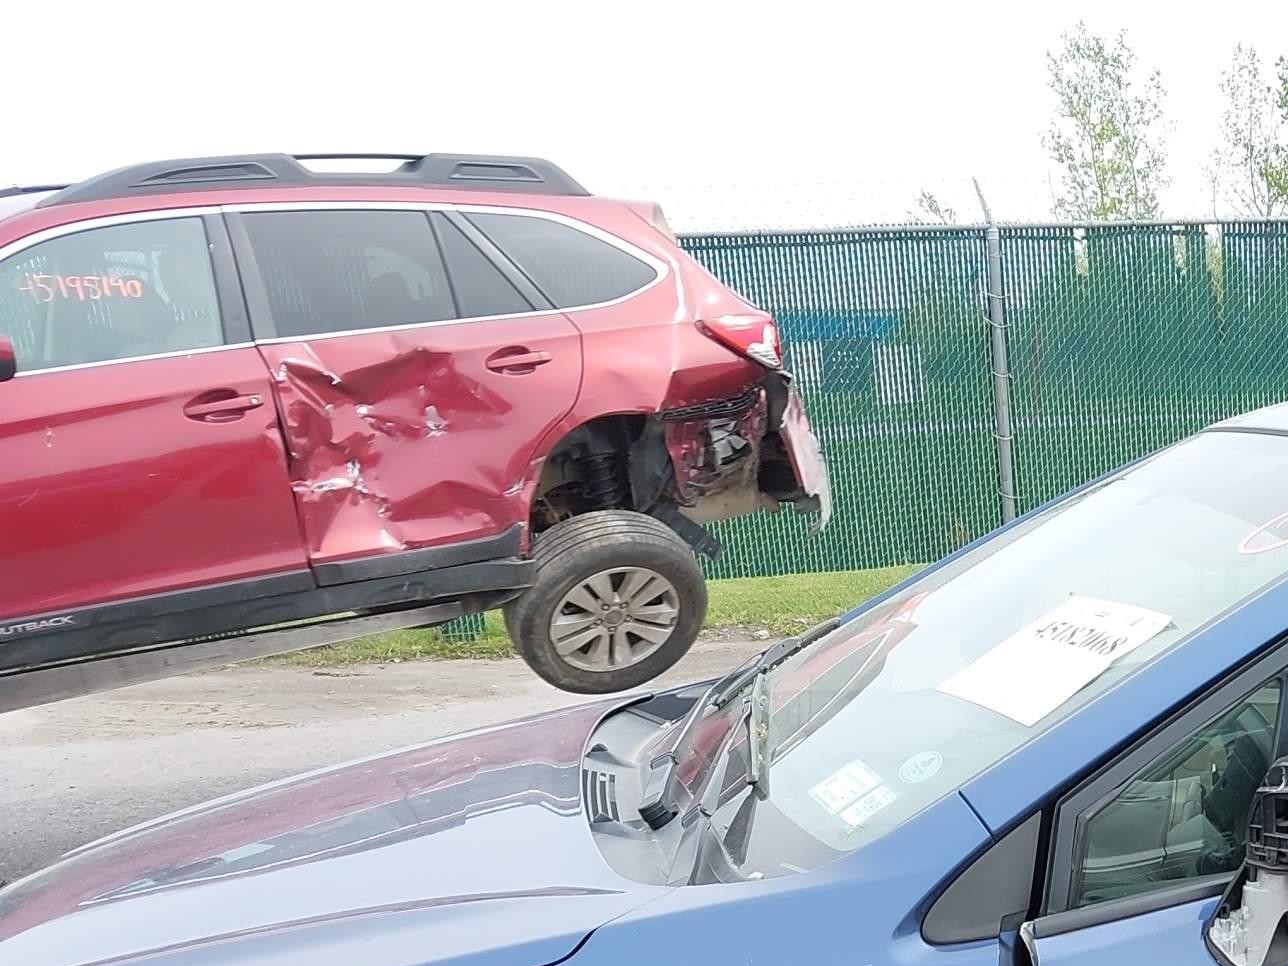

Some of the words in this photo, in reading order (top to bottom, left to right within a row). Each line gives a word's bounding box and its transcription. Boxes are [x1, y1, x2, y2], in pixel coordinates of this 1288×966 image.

[18, 273, 142, 303] 45195140
[0, 615, 74, 635] UTBACK
[1034, 620, 1129, 656] 45182068
